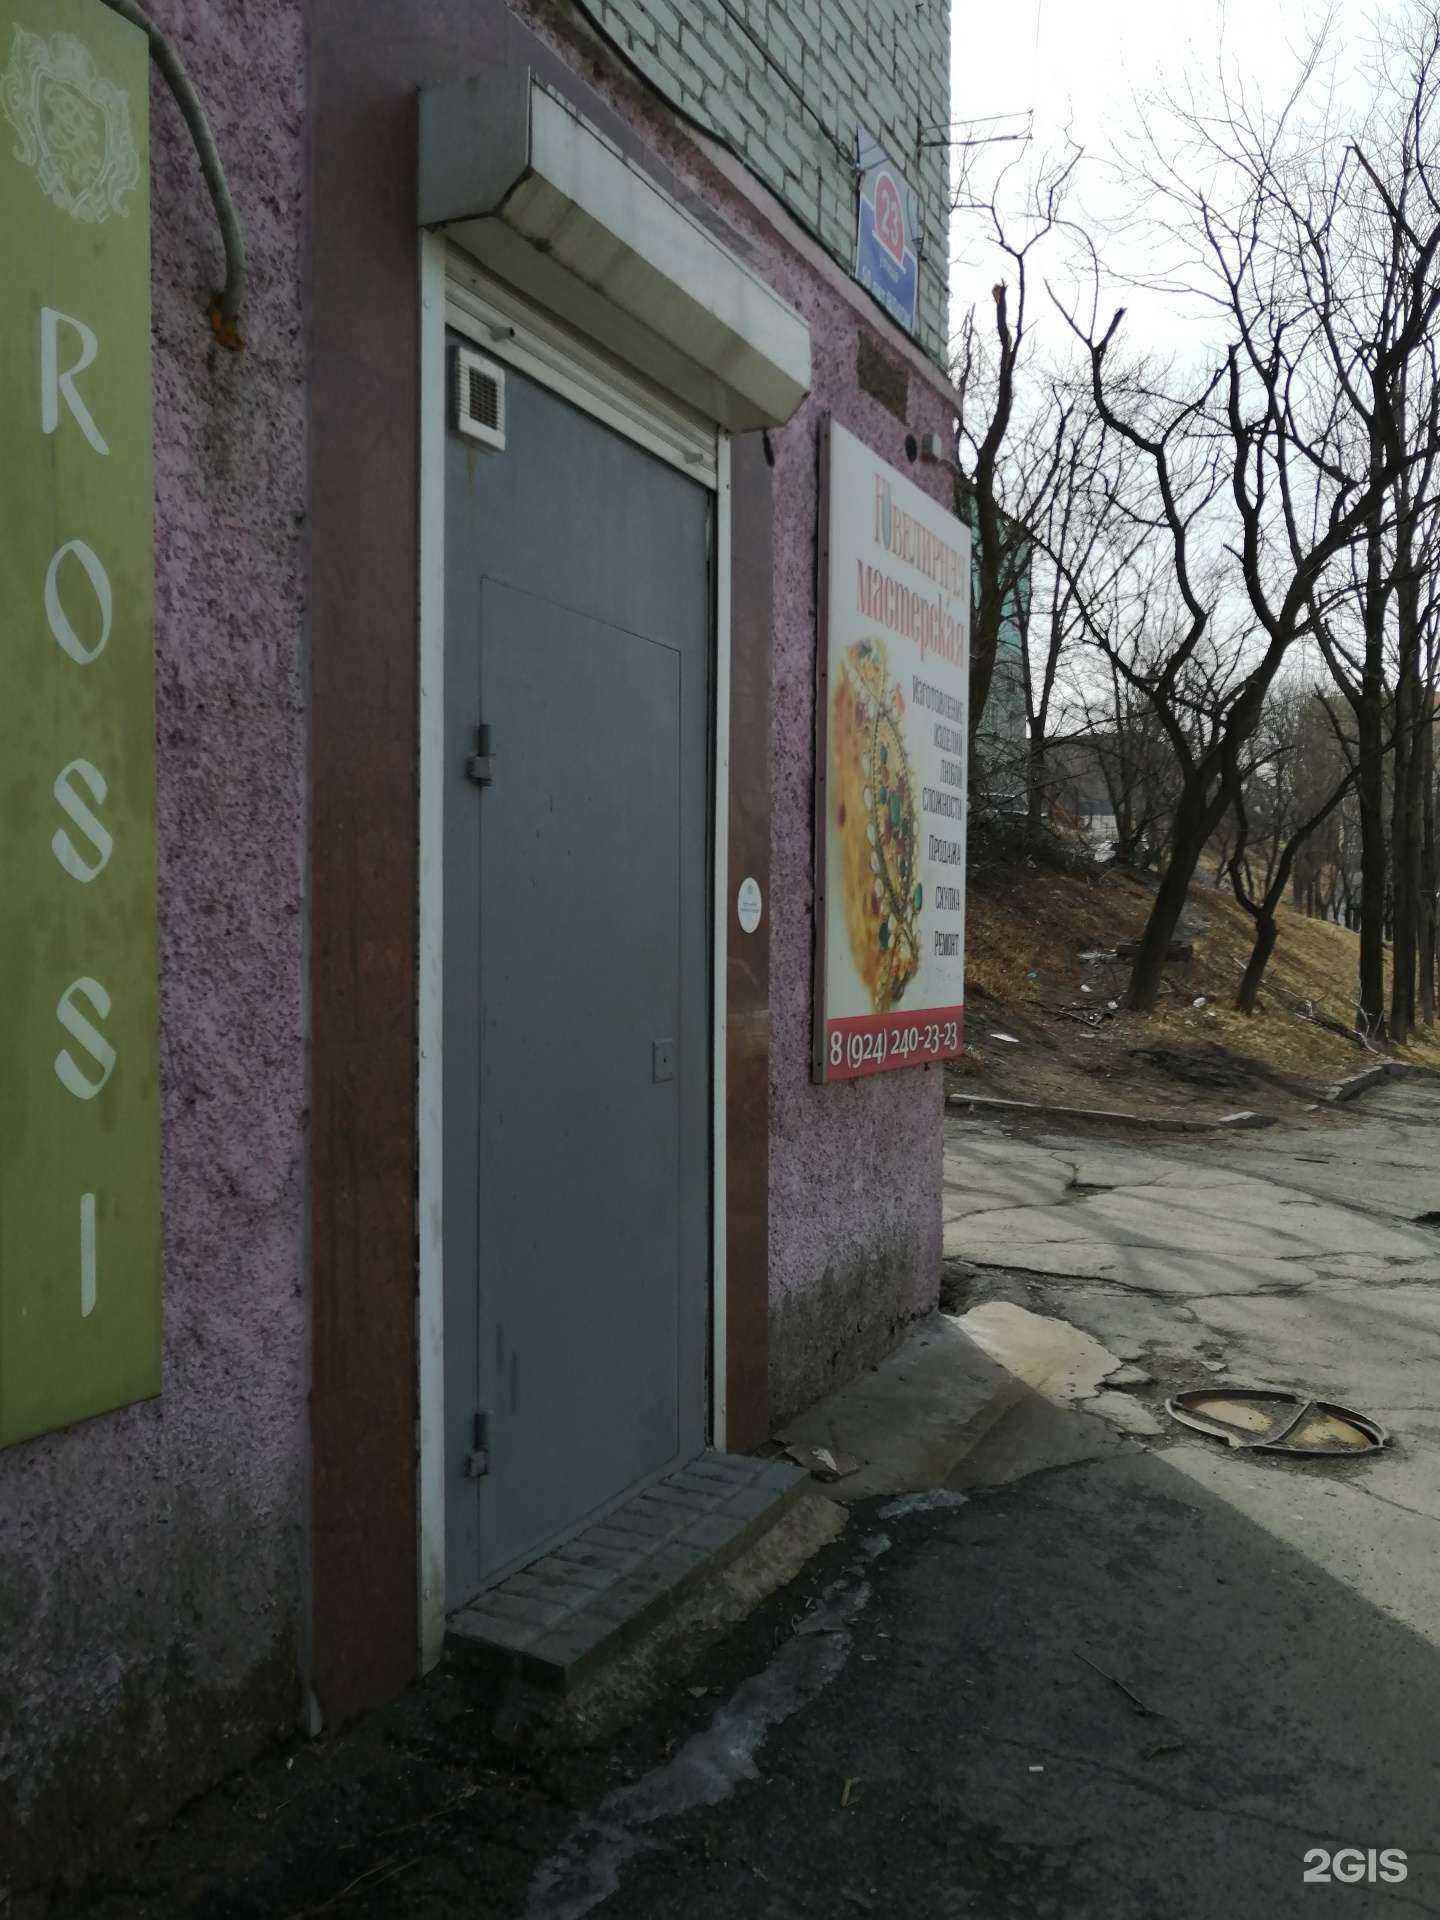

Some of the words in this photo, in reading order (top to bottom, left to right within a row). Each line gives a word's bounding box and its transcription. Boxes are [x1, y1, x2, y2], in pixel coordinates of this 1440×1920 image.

[41, 307, 117, 1318] ROSSI
[830, 1031, 843, 1066] 8
[847, 1028, 887, 1068] (924)
[890, 1022, 958, 1059] 240-23-23
